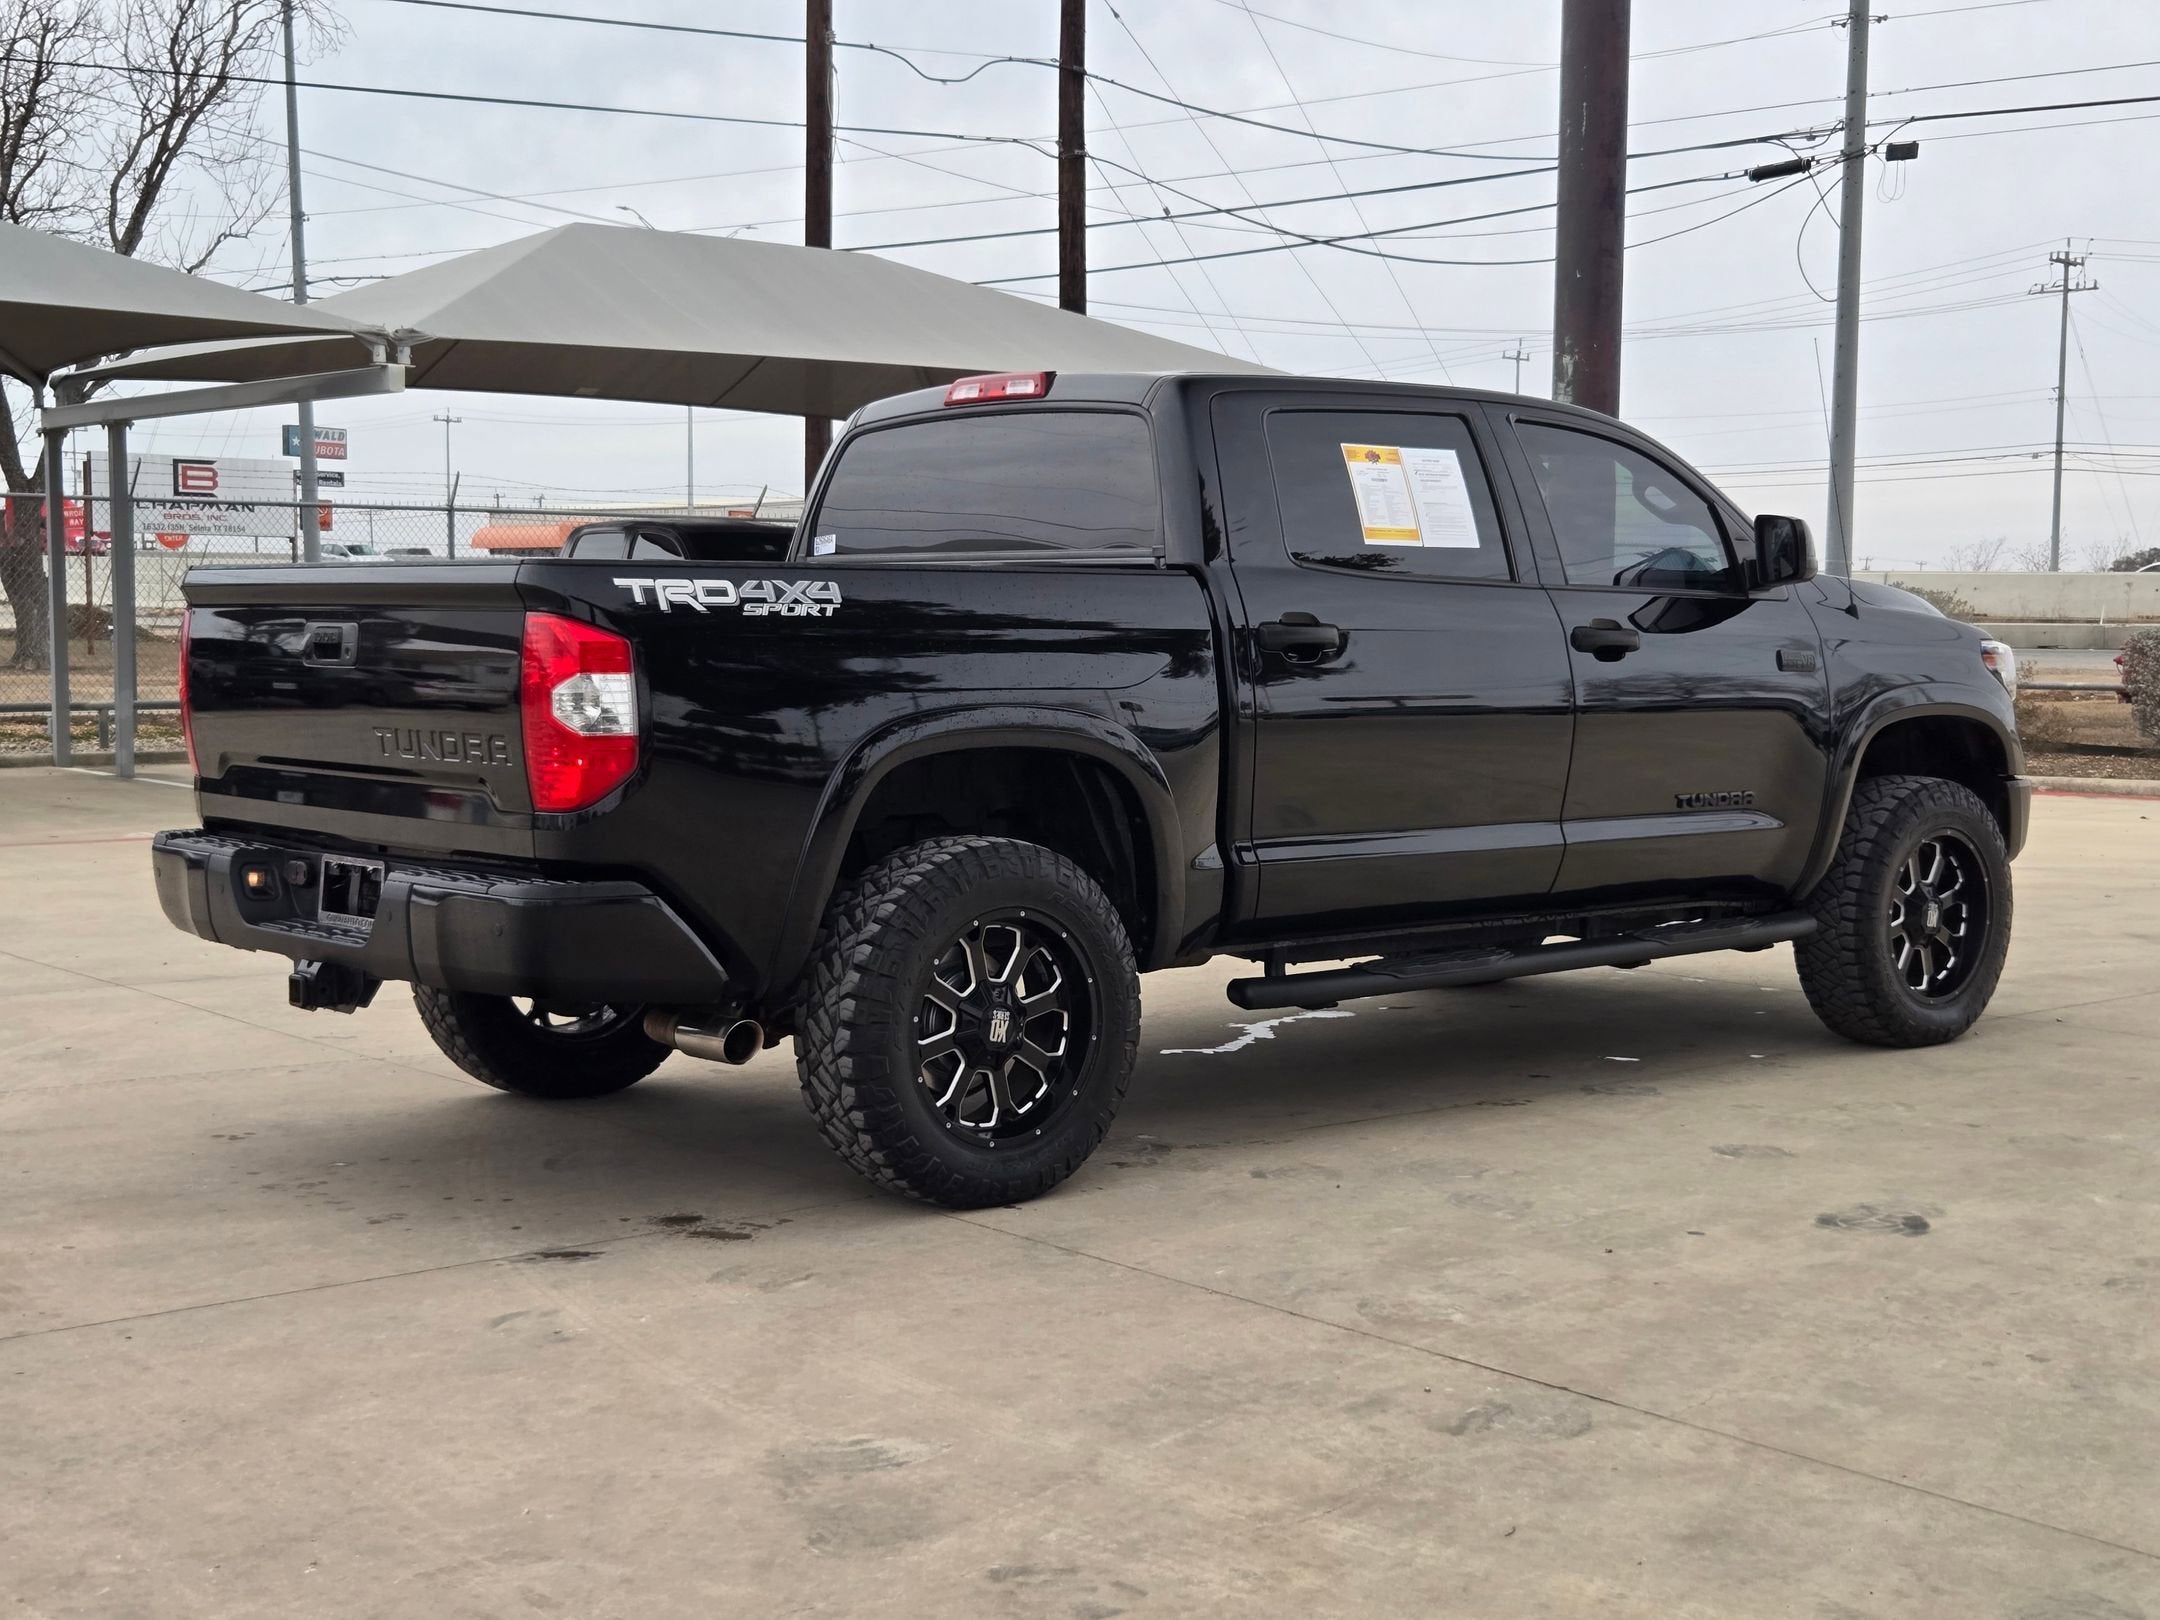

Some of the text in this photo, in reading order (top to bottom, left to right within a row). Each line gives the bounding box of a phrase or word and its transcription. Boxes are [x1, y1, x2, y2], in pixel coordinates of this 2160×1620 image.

[314, 429, 345, 441] WALD
[315, 445, 345, 457] UBOTA
[742, 603, 841, 617] SPORT
[372, 726, 513, 767] TUNDRA
[1675, 790, 1756, 809] TUNDRA
